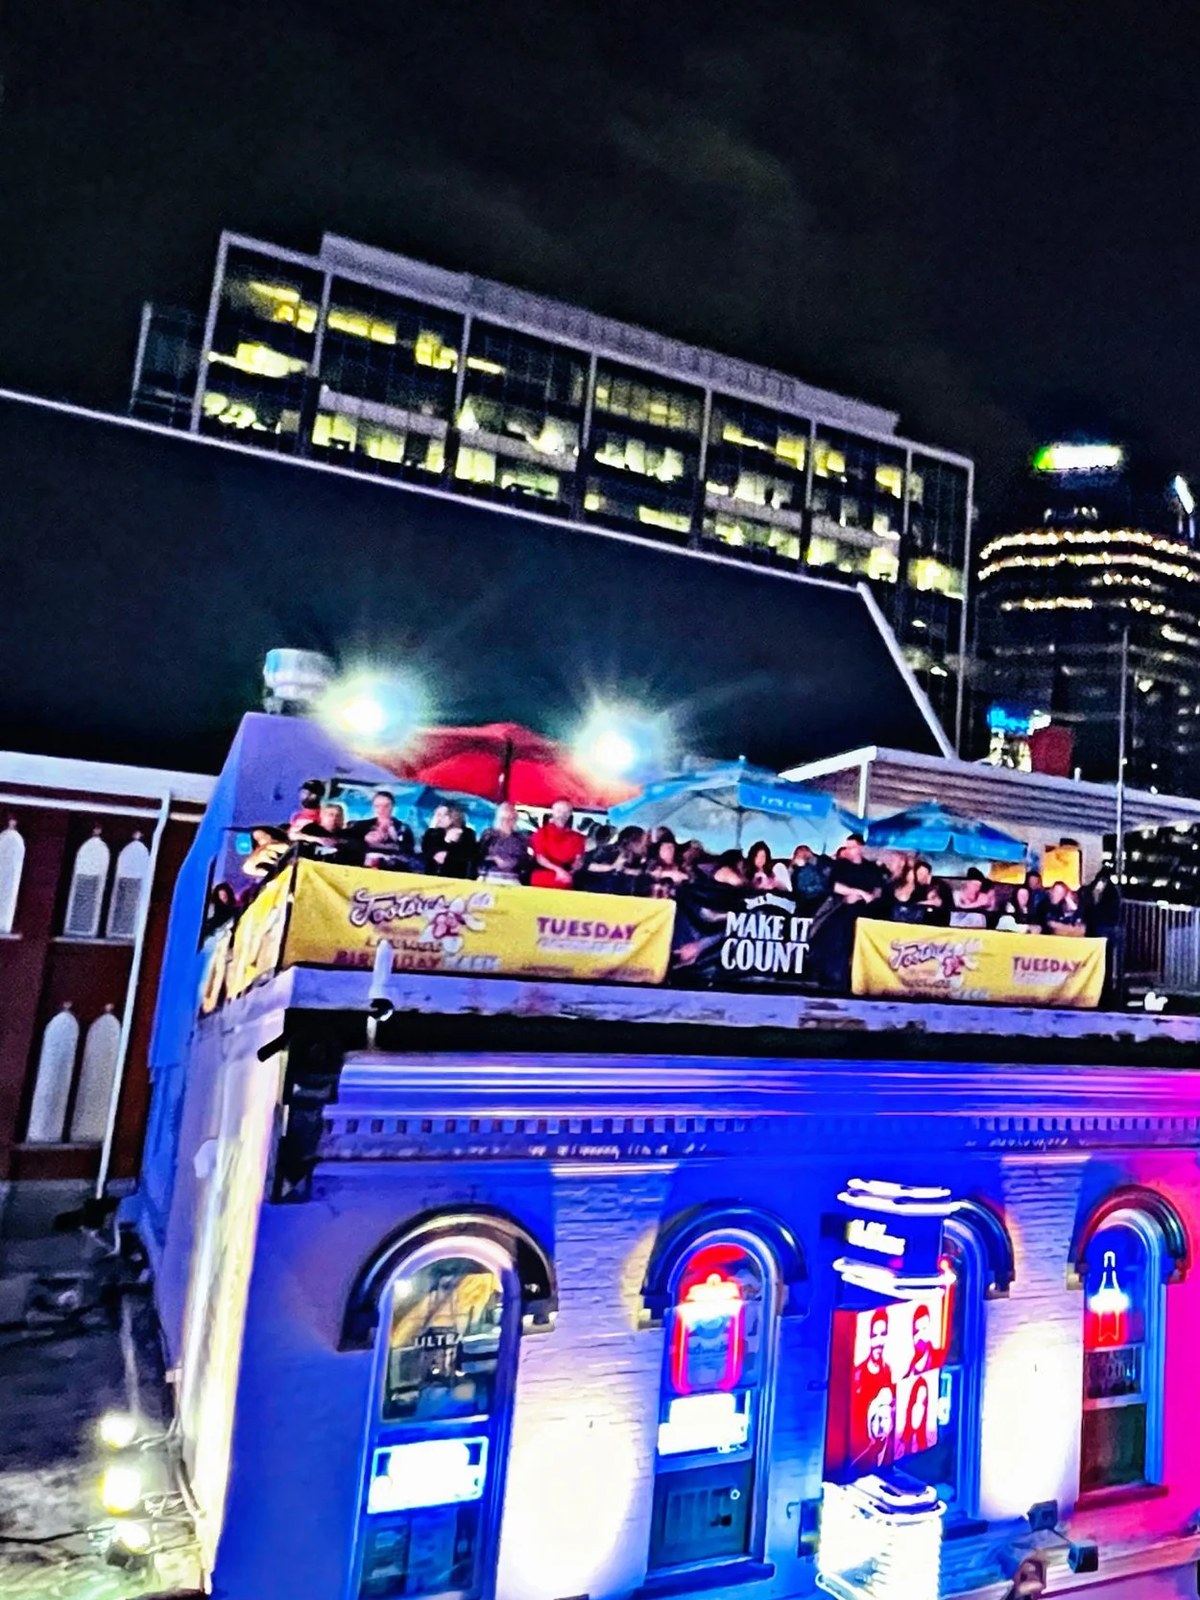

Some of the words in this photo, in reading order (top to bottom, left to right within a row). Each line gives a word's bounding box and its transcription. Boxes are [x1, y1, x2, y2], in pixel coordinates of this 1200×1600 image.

[537, 917, 639, 940] TUESDAY
[726, 911, 785, 941] MAKE
[790, 917, 813, 942] IT
[334, 951, 441, 970] BIRDAY
[721, 938, 810, 974] COUNT
[1012, 956, 1085, 973] TUESDAY
